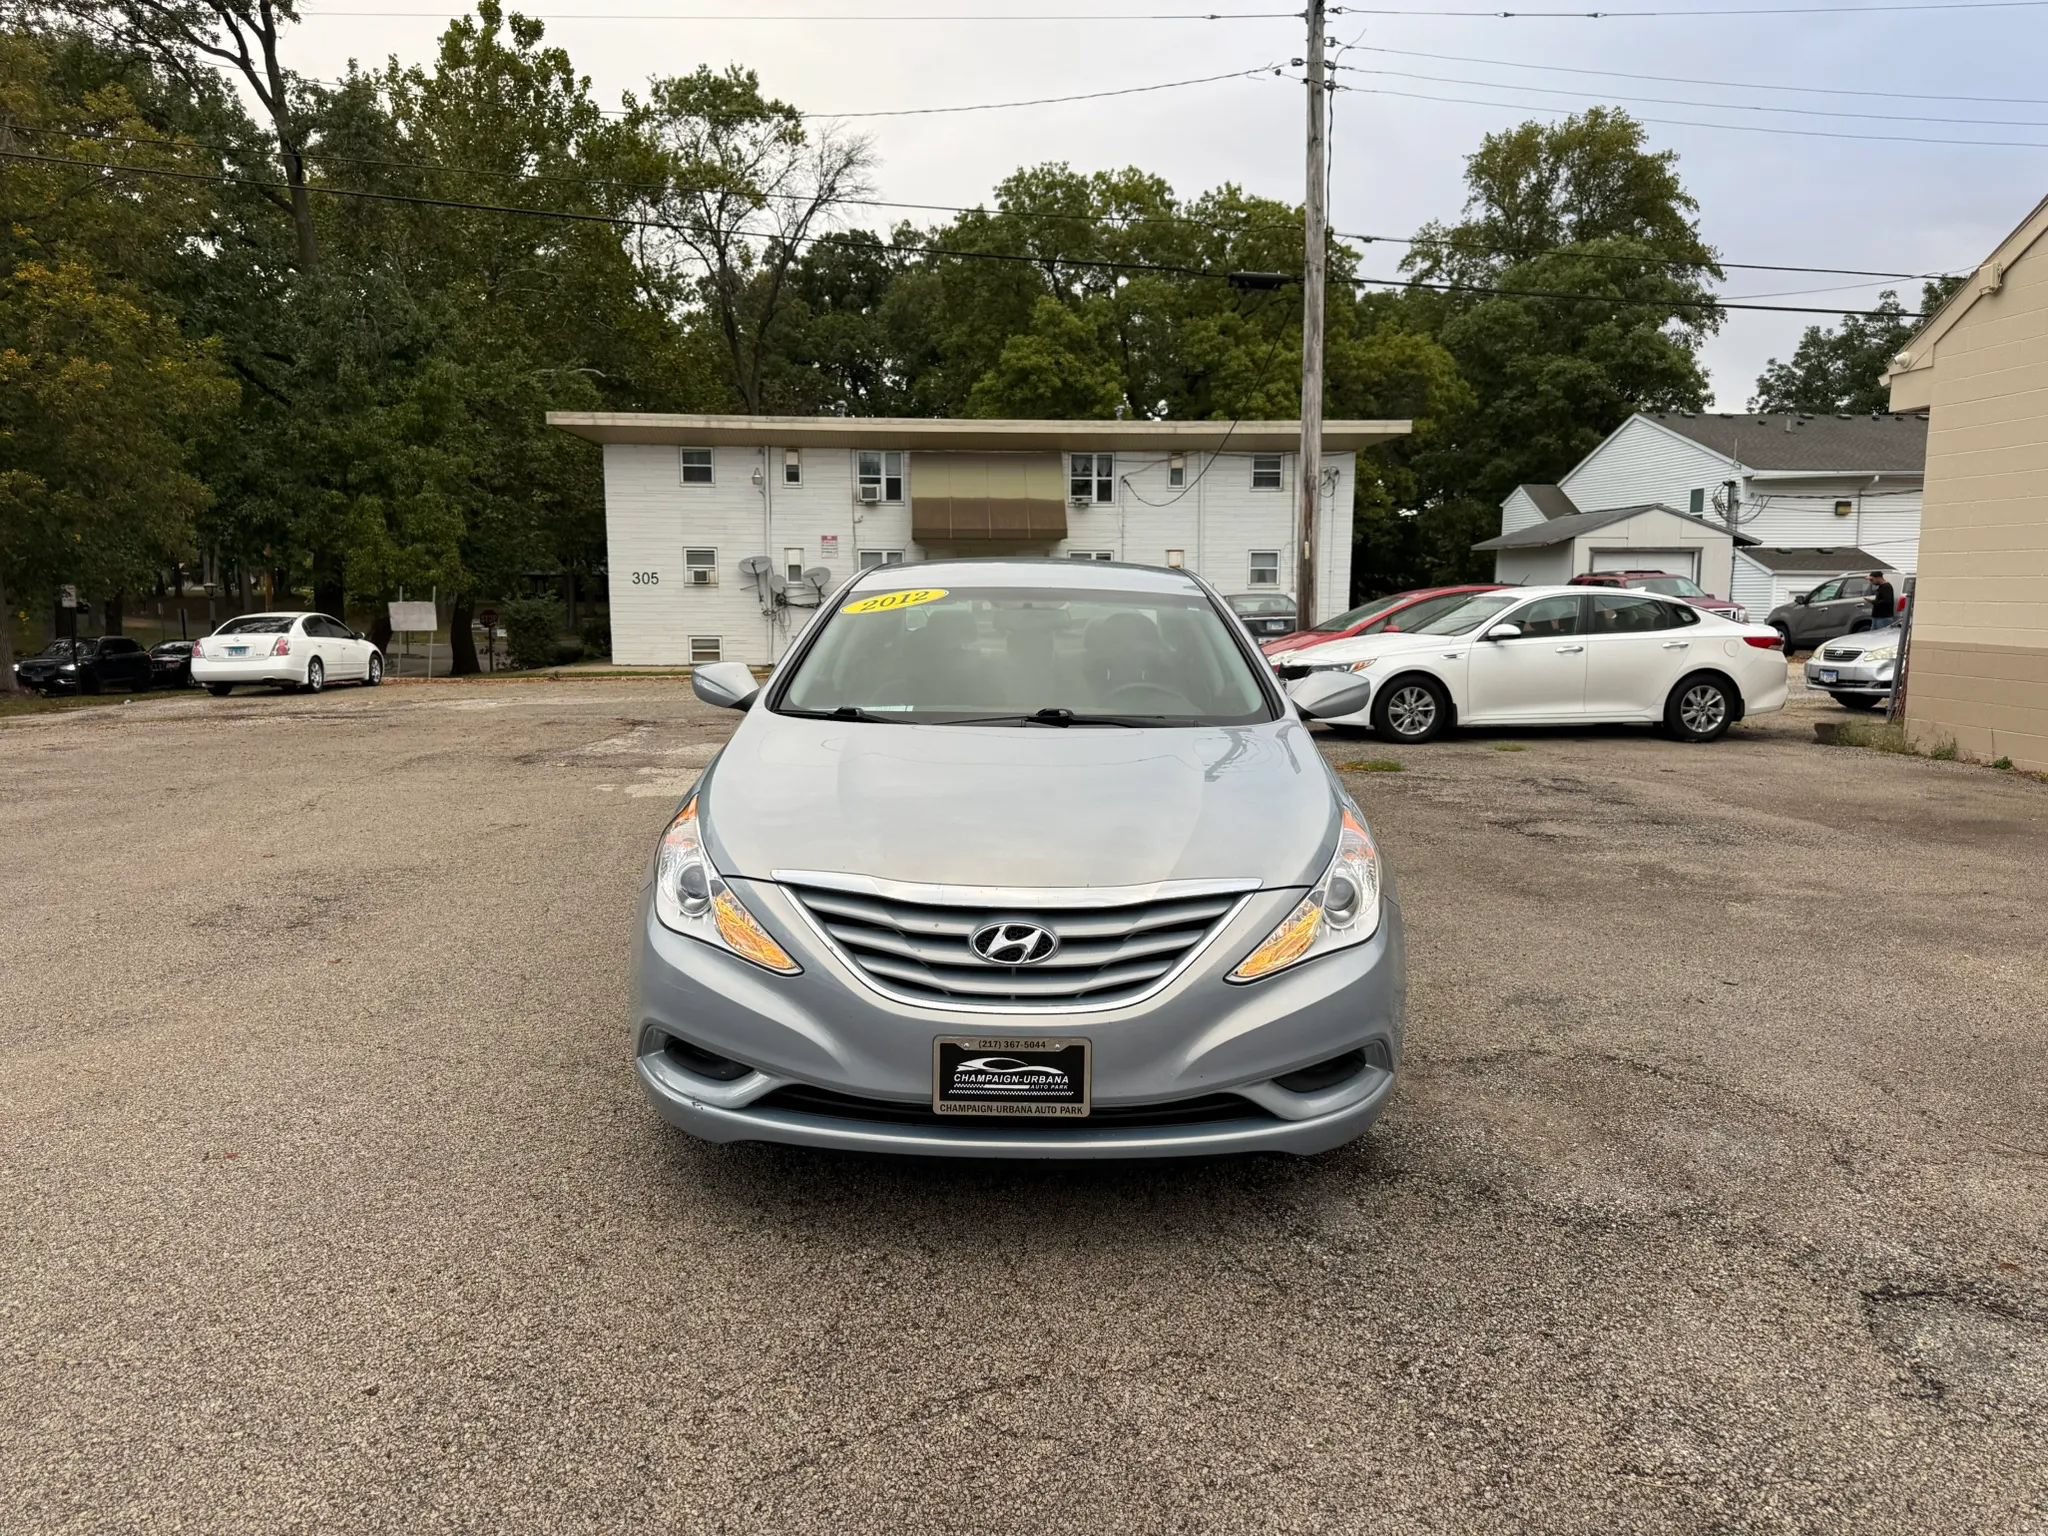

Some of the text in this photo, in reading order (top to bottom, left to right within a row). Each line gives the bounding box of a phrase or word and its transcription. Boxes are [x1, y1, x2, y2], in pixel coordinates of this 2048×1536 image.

[632, 571, 659, 585] 305
[860, 591, 930, 612] 2012
[978, 1040, 1046, 1049] (217) 367-5044
[953, 1073, 1069, 1084] CHAMPAIGN-URBANA
[940, 1103, 1084, 1115] CHAMPAIGN-URBANA AUTO PARK
